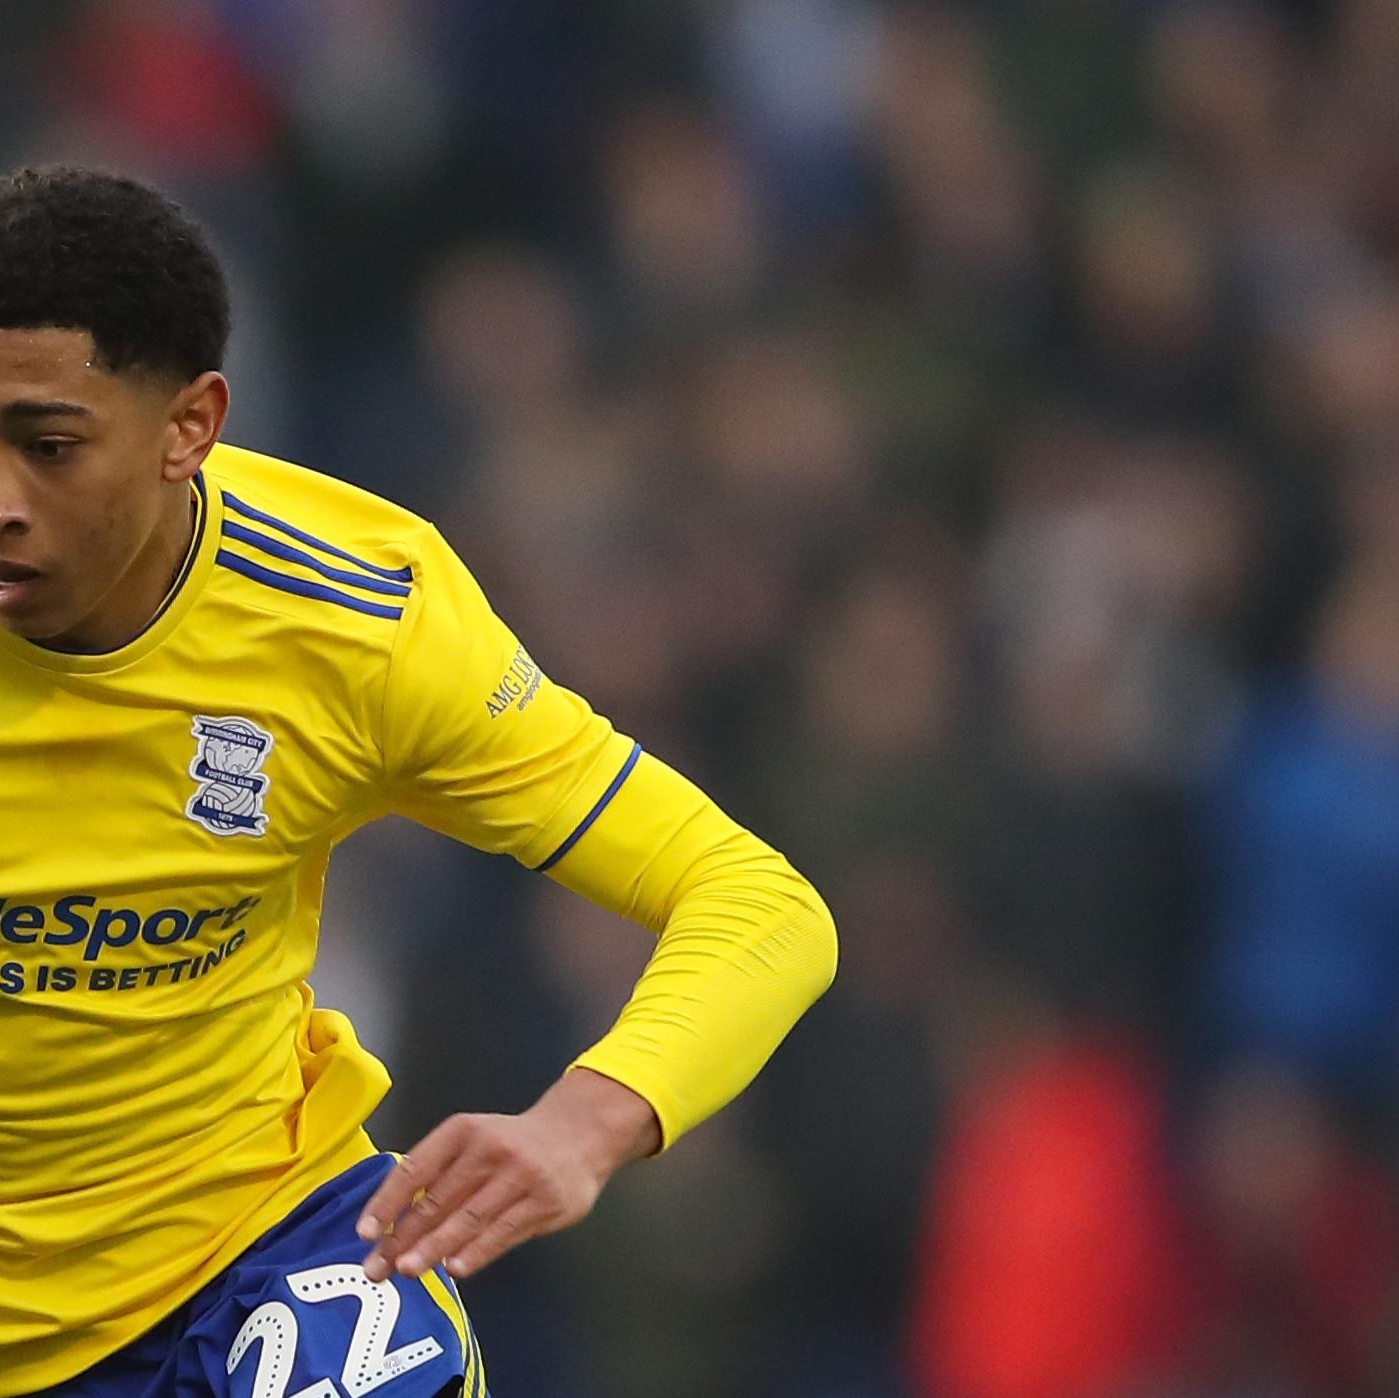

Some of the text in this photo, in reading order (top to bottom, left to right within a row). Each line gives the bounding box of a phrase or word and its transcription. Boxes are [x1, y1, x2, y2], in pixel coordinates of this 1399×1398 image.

[485, 674, 522, 719] AMG
[36, 965, 77, 992] IS
[88, 928, 246, 992] BETTING
